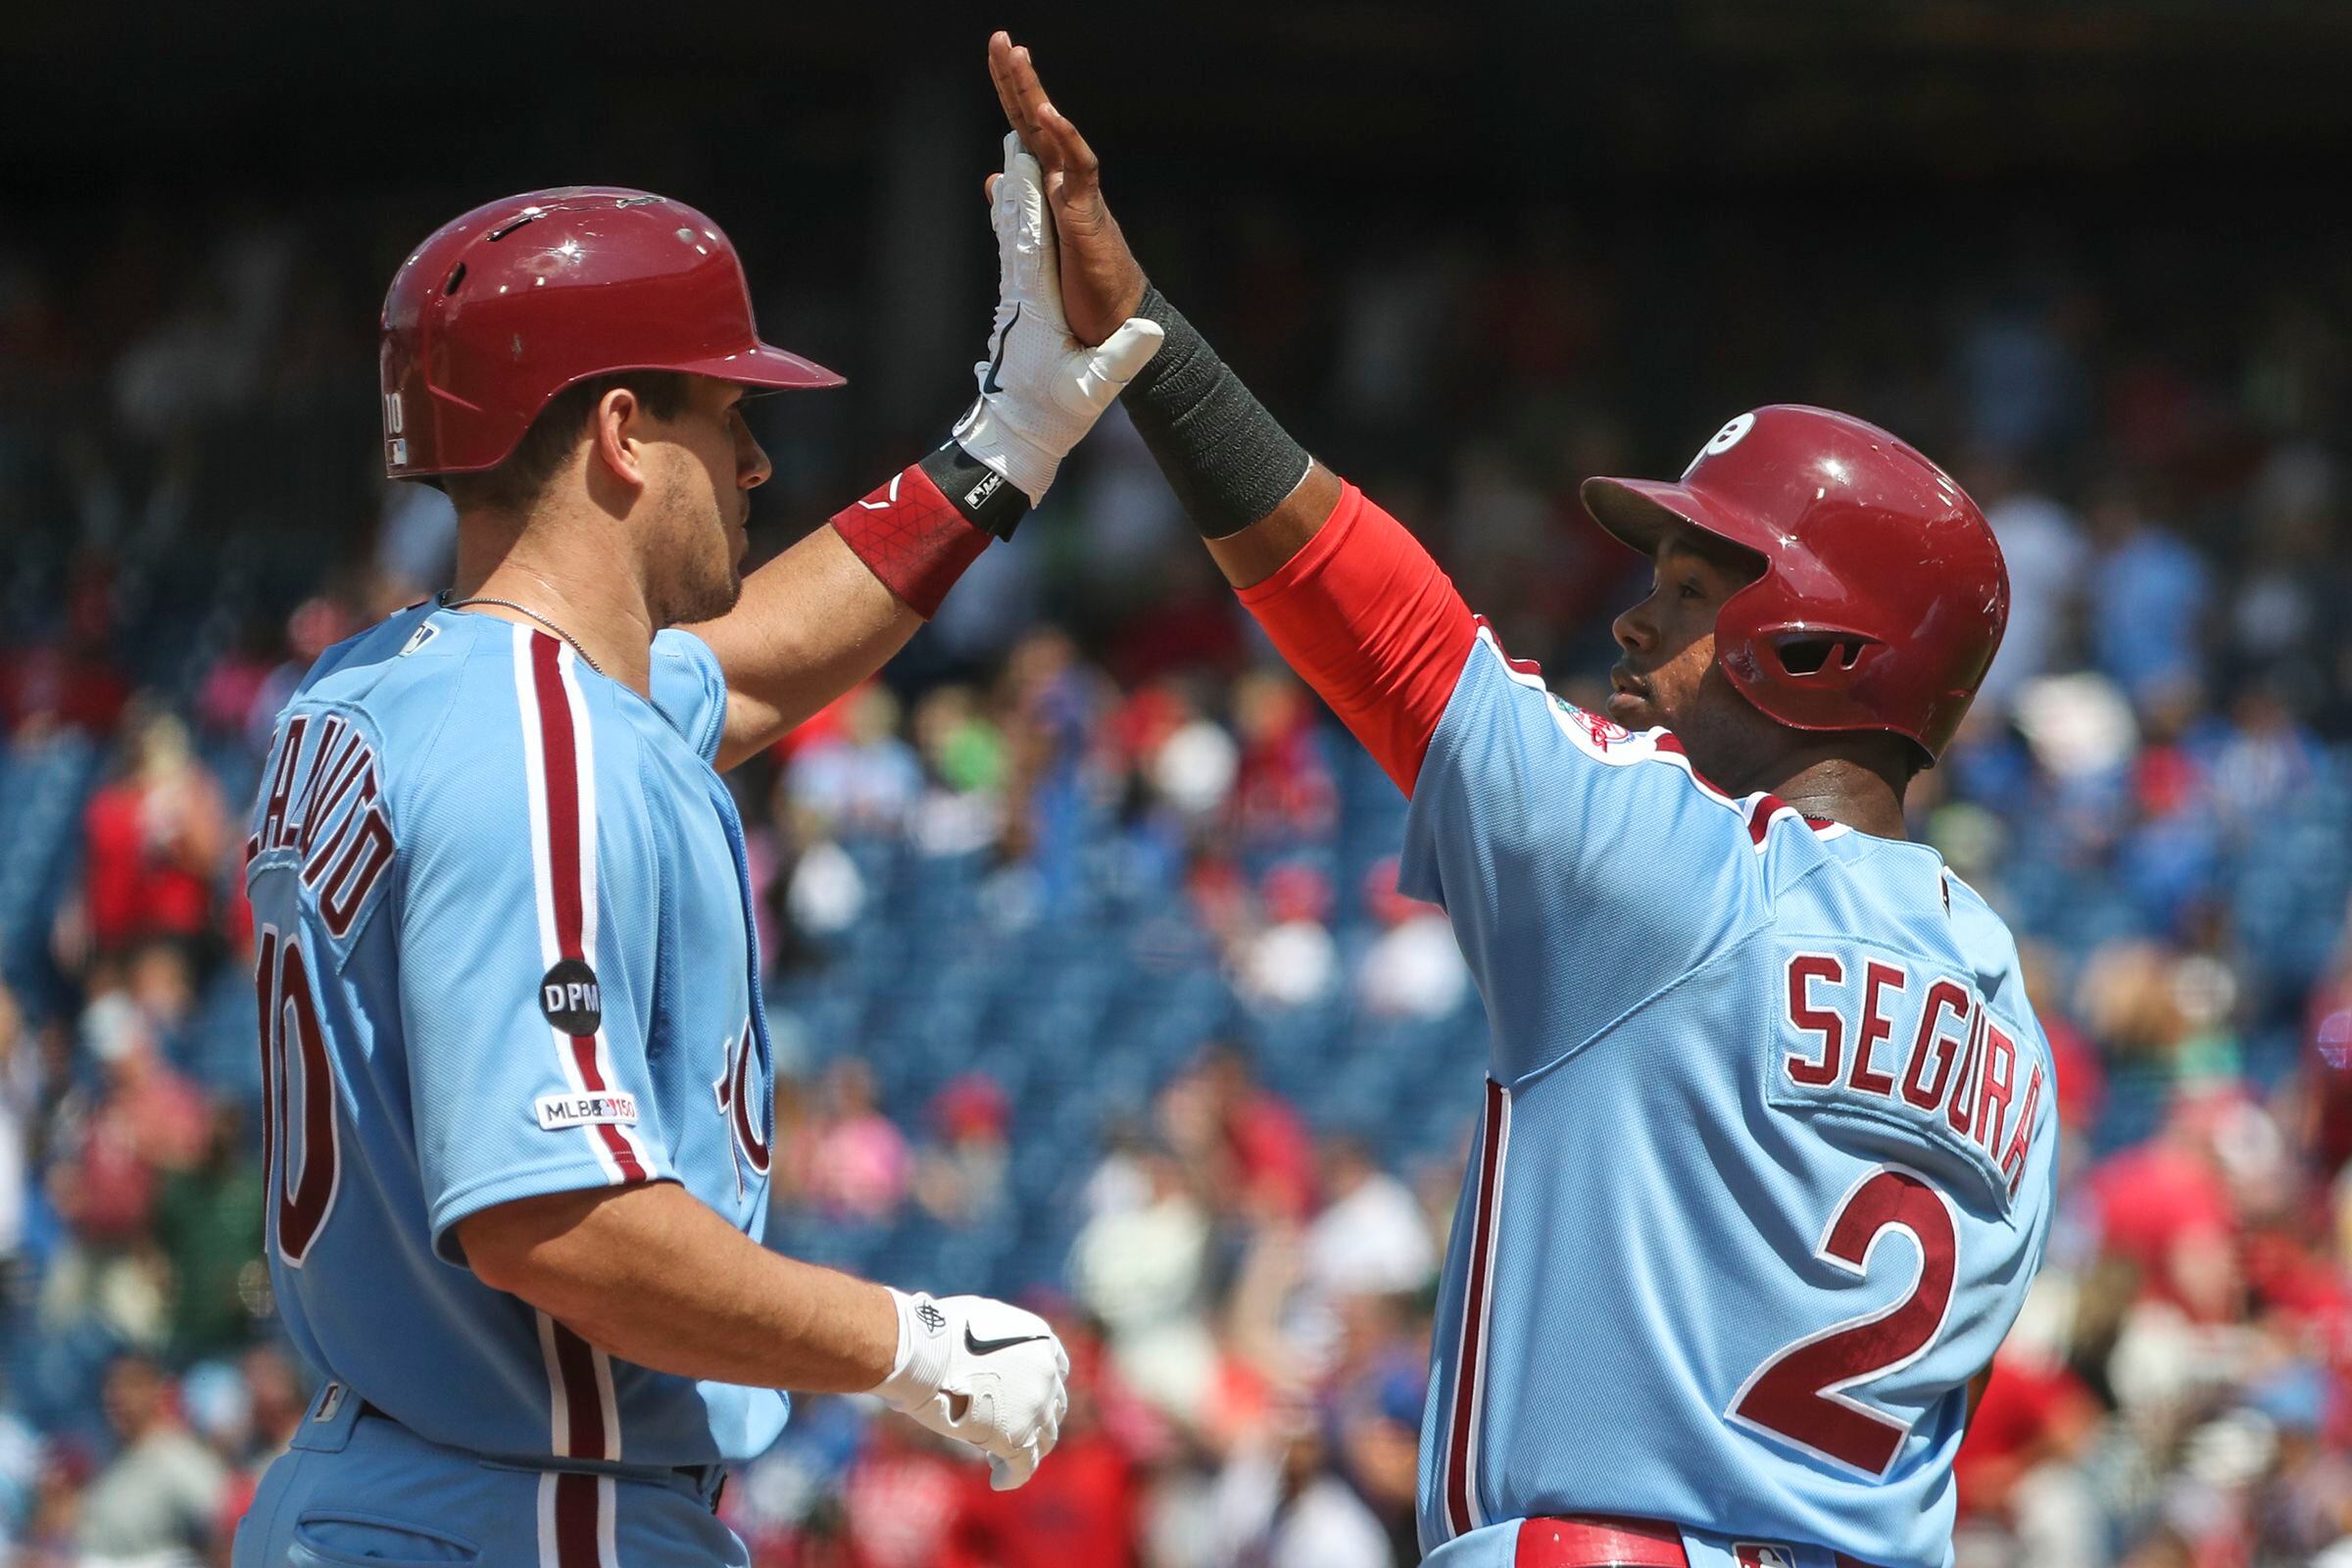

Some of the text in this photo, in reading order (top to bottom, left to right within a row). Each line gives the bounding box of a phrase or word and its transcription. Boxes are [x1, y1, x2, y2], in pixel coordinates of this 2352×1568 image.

[384, 393, 403, 434] 10
[1680, 412, 1755, 479] P
[544, 982, 600, 1013] DPM
[255, 921, 341, 1268] 10
[1784, 950, 2043, 1200] SEGURA
[545, 1098, 636, 1121] MLB 150
[1723, 1161, 1961, 1483] 2
